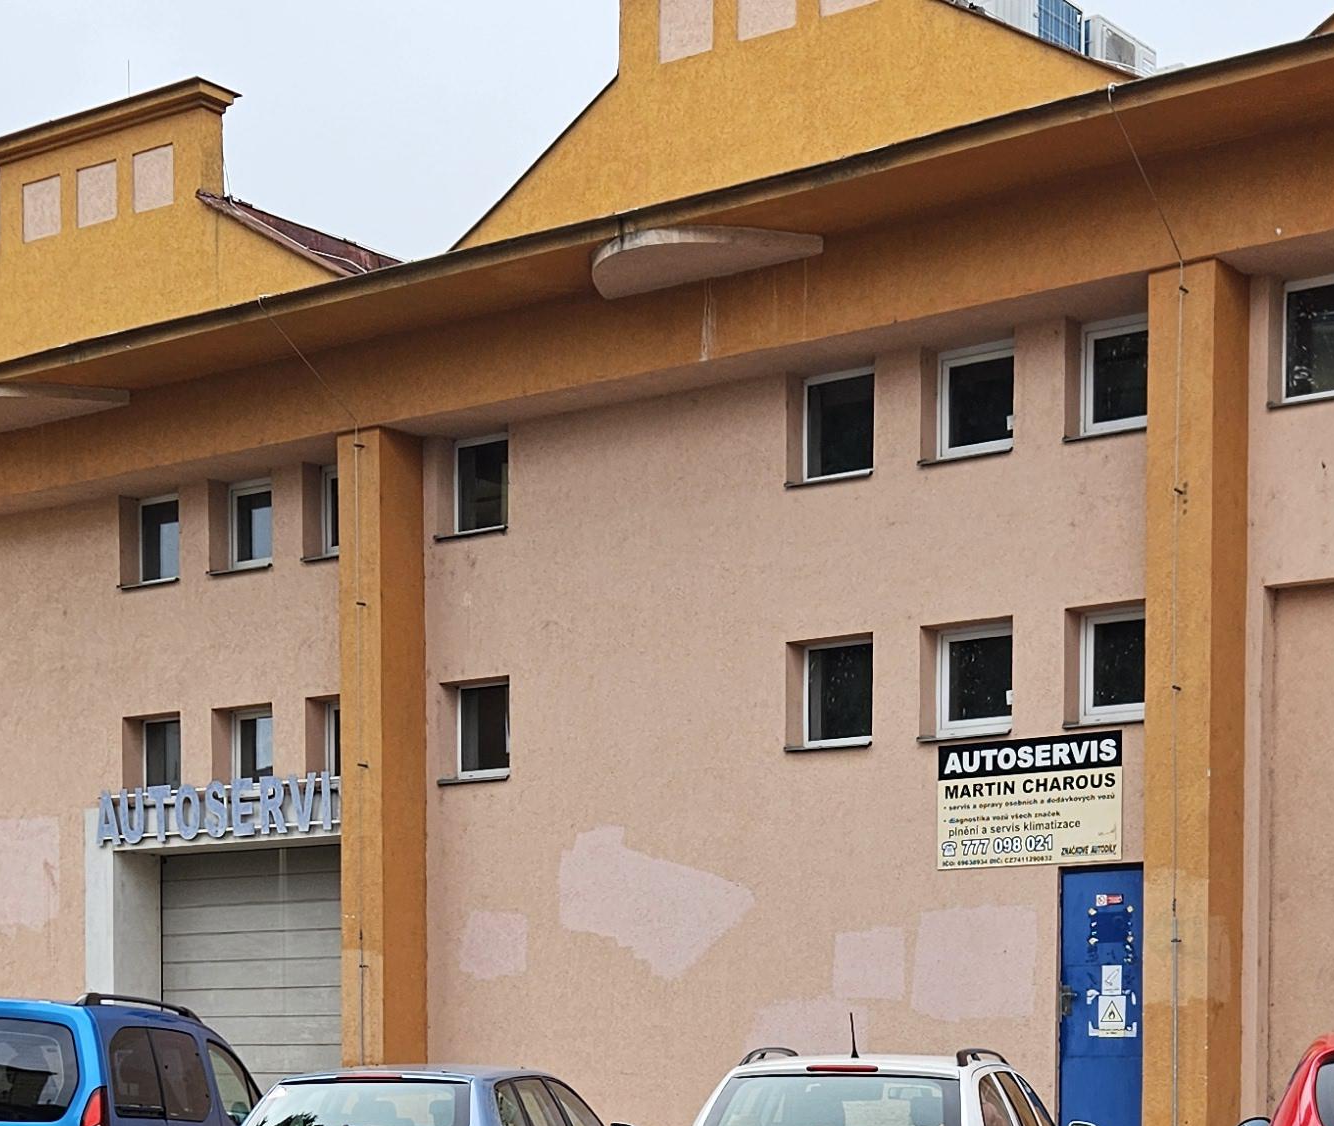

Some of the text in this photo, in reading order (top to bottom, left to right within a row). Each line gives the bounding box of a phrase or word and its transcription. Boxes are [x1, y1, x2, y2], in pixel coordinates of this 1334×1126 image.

[943, 738, 1117, 775] AUTOSERVIS
[944, 772, 1116, 800] MARTIN CHAROUS
[96, 770, 341, 848] AUTOSERVI
[948, 803, 971, 811] servis
[978, 801, 1003, 809] opravy
[948, 815, 990, 824] diagnostika
[1034, 810, 1061, 818] značek
[981, 827, 988, 835] a
[990, 822, 1021, 834] servis
[1023, 819, 1081, 832] klimatizace
[961, 834, 1054, 856] 777 098 021
